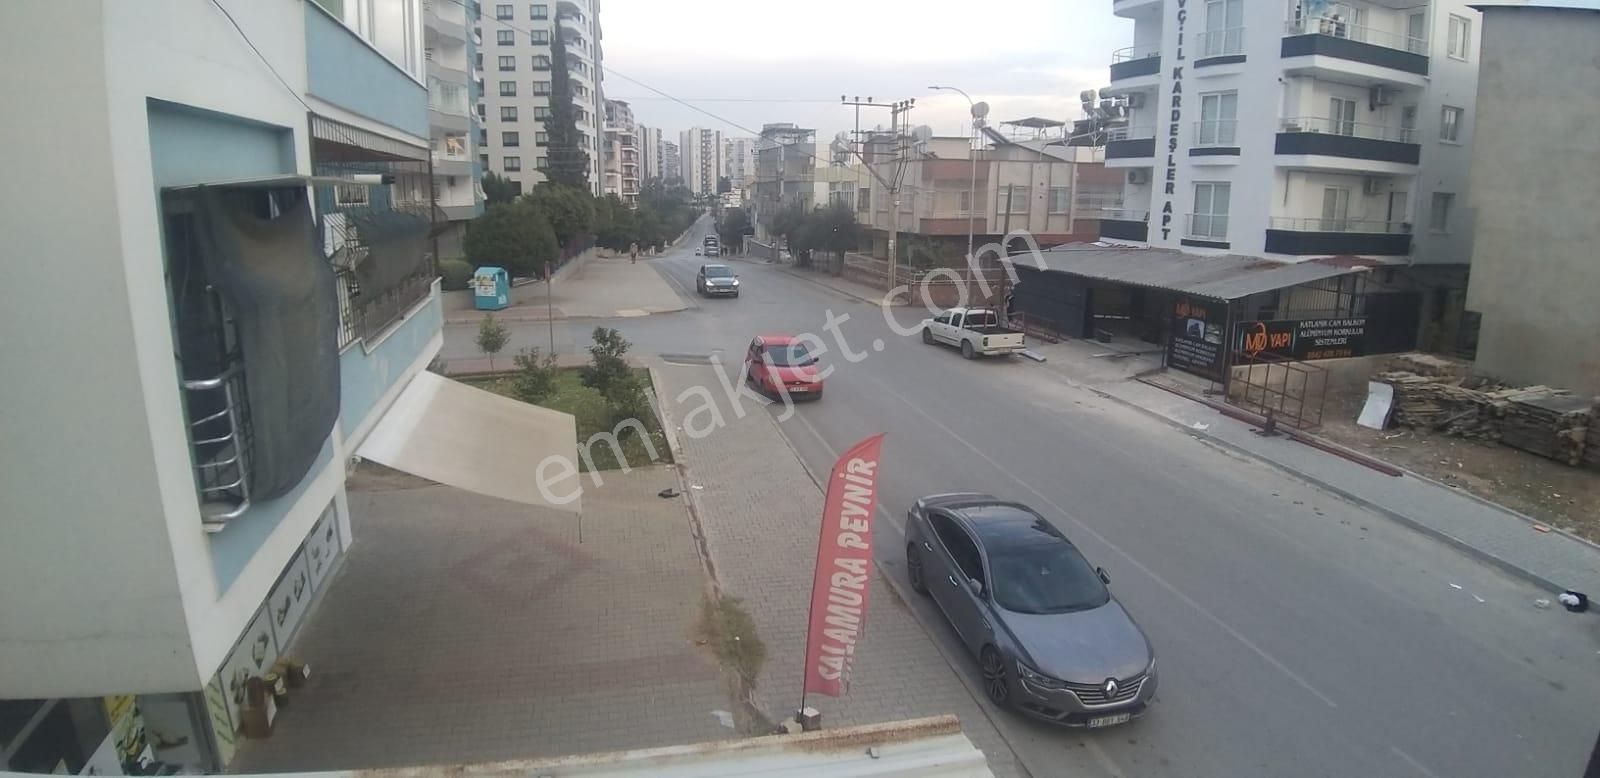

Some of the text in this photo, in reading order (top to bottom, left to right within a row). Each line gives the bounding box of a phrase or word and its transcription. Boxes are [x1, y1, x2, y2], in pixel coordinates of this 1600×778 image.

[1165, 66, 1183, 195] KARDEŞLER
[1161, 201, 1173, 241] APT
[1270, 332, 1291, 347] YAPI
[817, 457, 877, 681] SALAMURA PEYNİR
